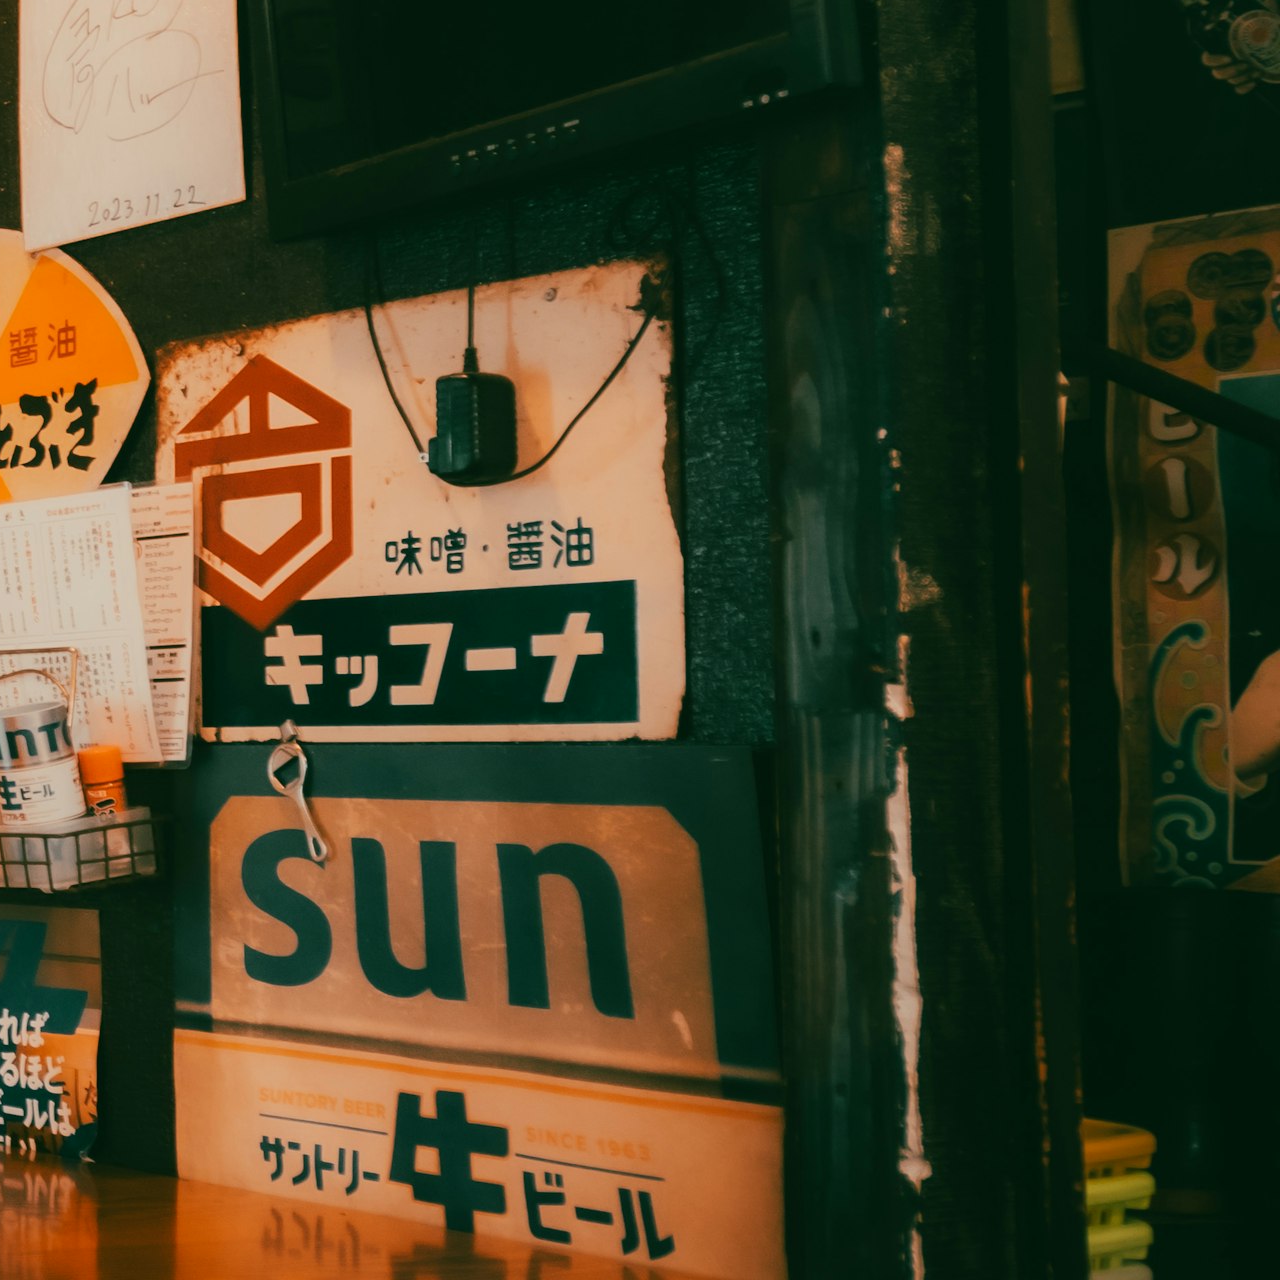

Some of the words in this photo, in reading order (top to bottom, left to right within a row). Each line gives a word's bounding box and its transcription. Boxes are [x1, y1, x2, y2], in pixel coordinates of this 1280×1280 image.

[86, 184, 208, 229] 2023.11.22
[263, 610, 605, 708] キッコーナ
[240, 826, 636, 1021] sun
[258, 1087, 339, 1114] SUNTORY
[343, 1099, 387, 1121] BEER
[524, 1126, 589, 1152] SINCE
[595, 1138, 653, 1163] 1963
